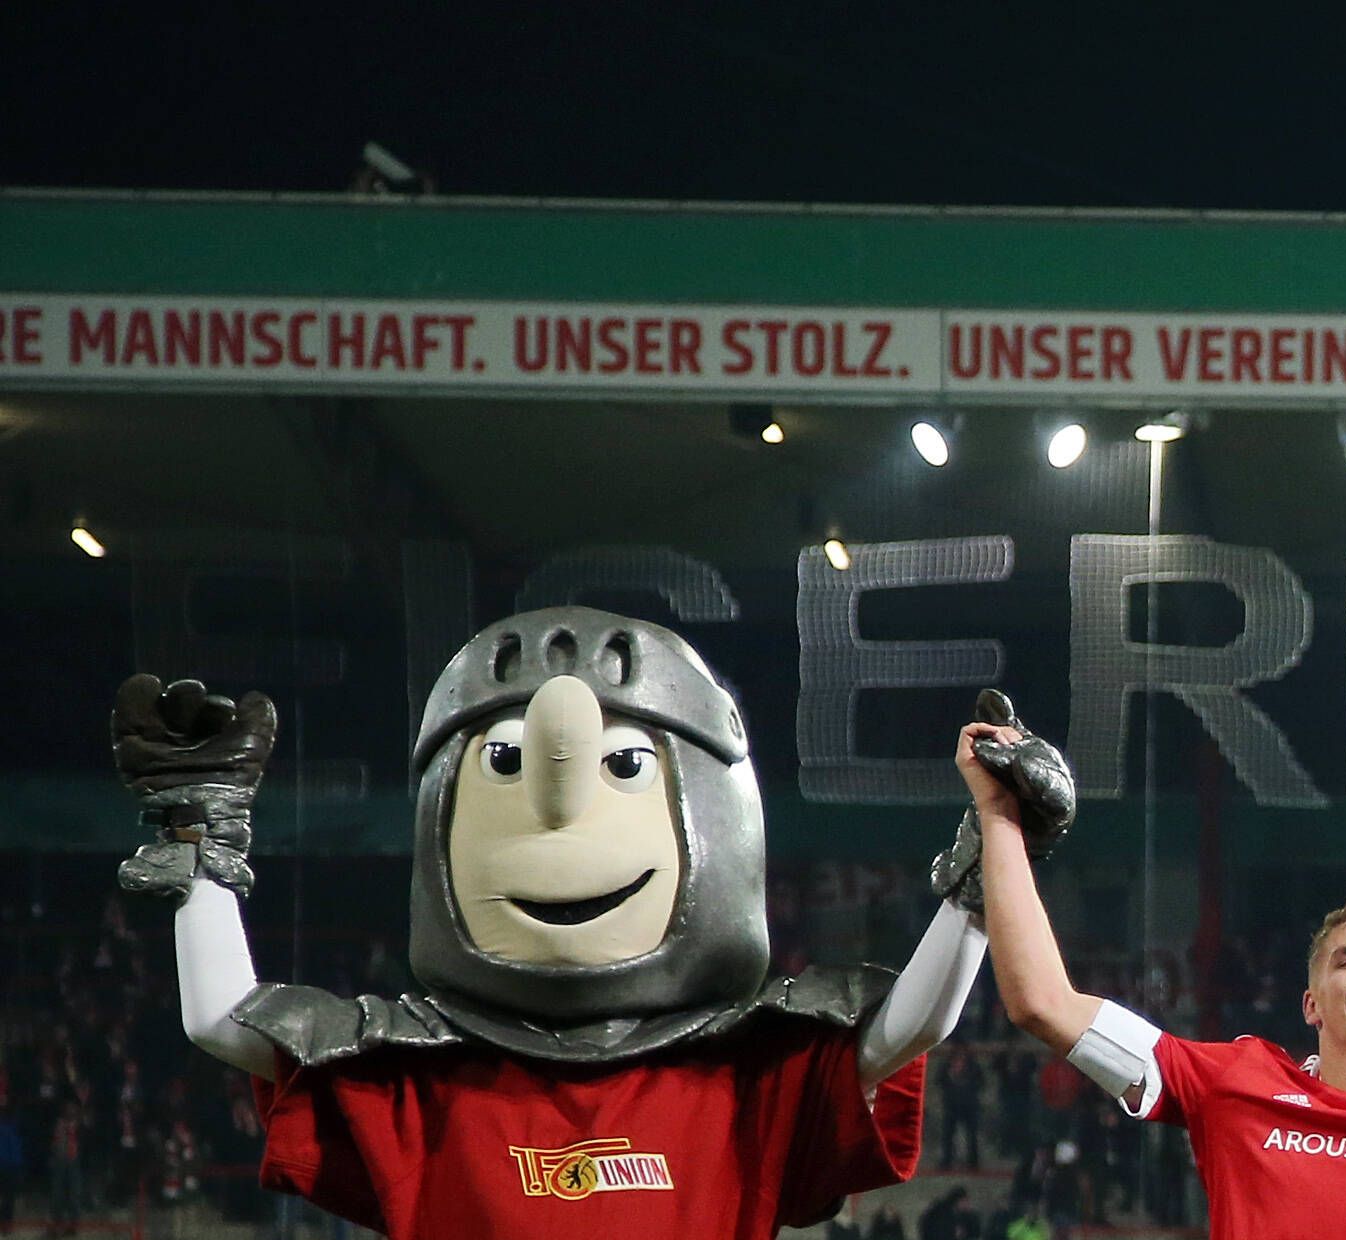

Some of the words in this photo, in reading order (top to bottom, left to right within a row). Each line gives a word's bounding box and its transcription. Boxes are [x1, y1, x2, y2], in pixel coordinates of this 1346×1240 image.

[0, 307, 42, 366] E
[69, 308, 486, 372] MANNSCHAFT.
[515, 314, 702, 376] UNSER
[722, 318, 911, 379] STOLZ.
[949, 323, 1134, 381] UNSER
[599, 1157, 669, 1187] UNION
